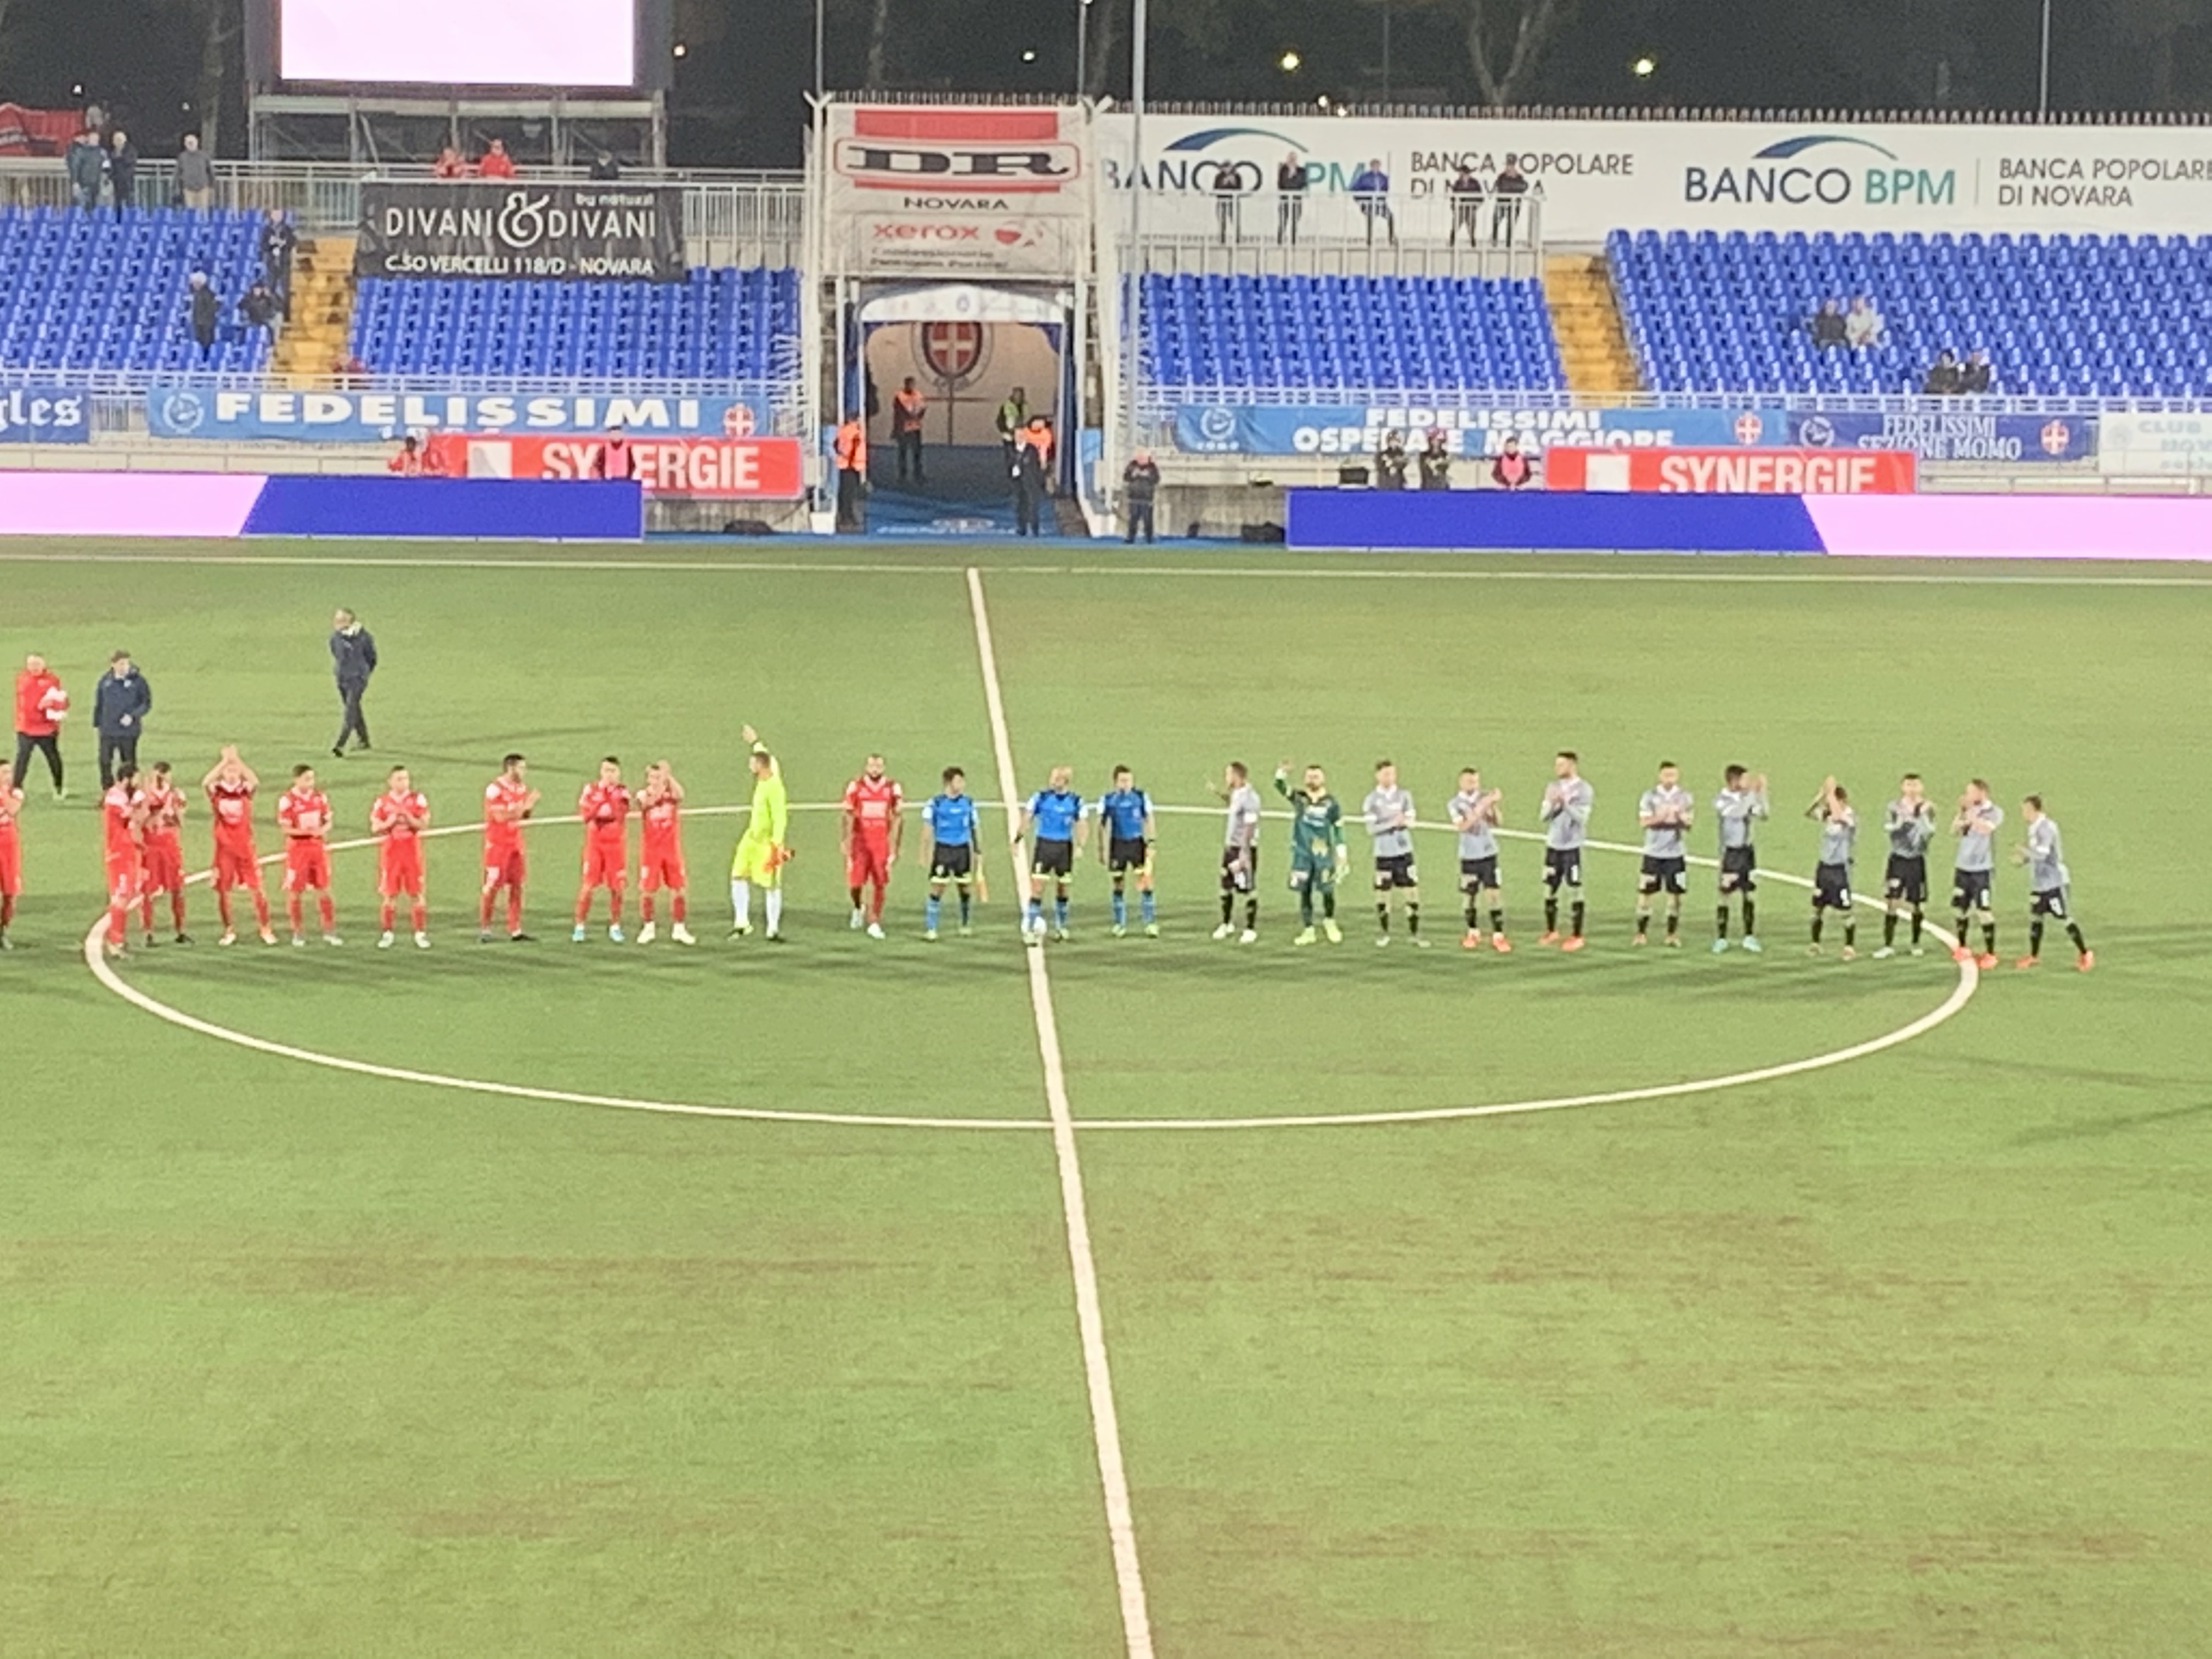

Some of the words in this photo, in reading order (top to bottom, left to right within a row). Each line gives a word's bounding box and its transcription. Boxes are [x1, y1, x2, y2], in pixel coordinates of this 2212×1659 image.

[848, 145, 1069, 176] DR
[1410, 151, 1497, 173] BANCA
[1999, 157, 2085, 180] BANCA
[1684, 167, 1852, 204] BANCO
[1864, 168, 1956, 205] BPM
[1999, 185, 2023, 206] DI
[2031, 185, 2134, 207] NOVARA
[904, 197, 1009, 210] NOVARA
[386, 208, 493, 238] DIVANI
[498, 192, 550, 248] &
[548, 210, 656, 238] DIVANI
[873, 224, 979, 240] xerox
[430, 255, 509, 274] VERCELLI
[579, 257, 654, 275] NOVARA
[216, 393, 699, 428] FEDELISSIMI
[1366, 408, 1601, 429] FEDELISSIMI
[1883, 414, 1996, 438] FEDELISSIMI
[1953, 436, 2023, 460] MOMO
[541, 442, 759, 489] SYERGIE
